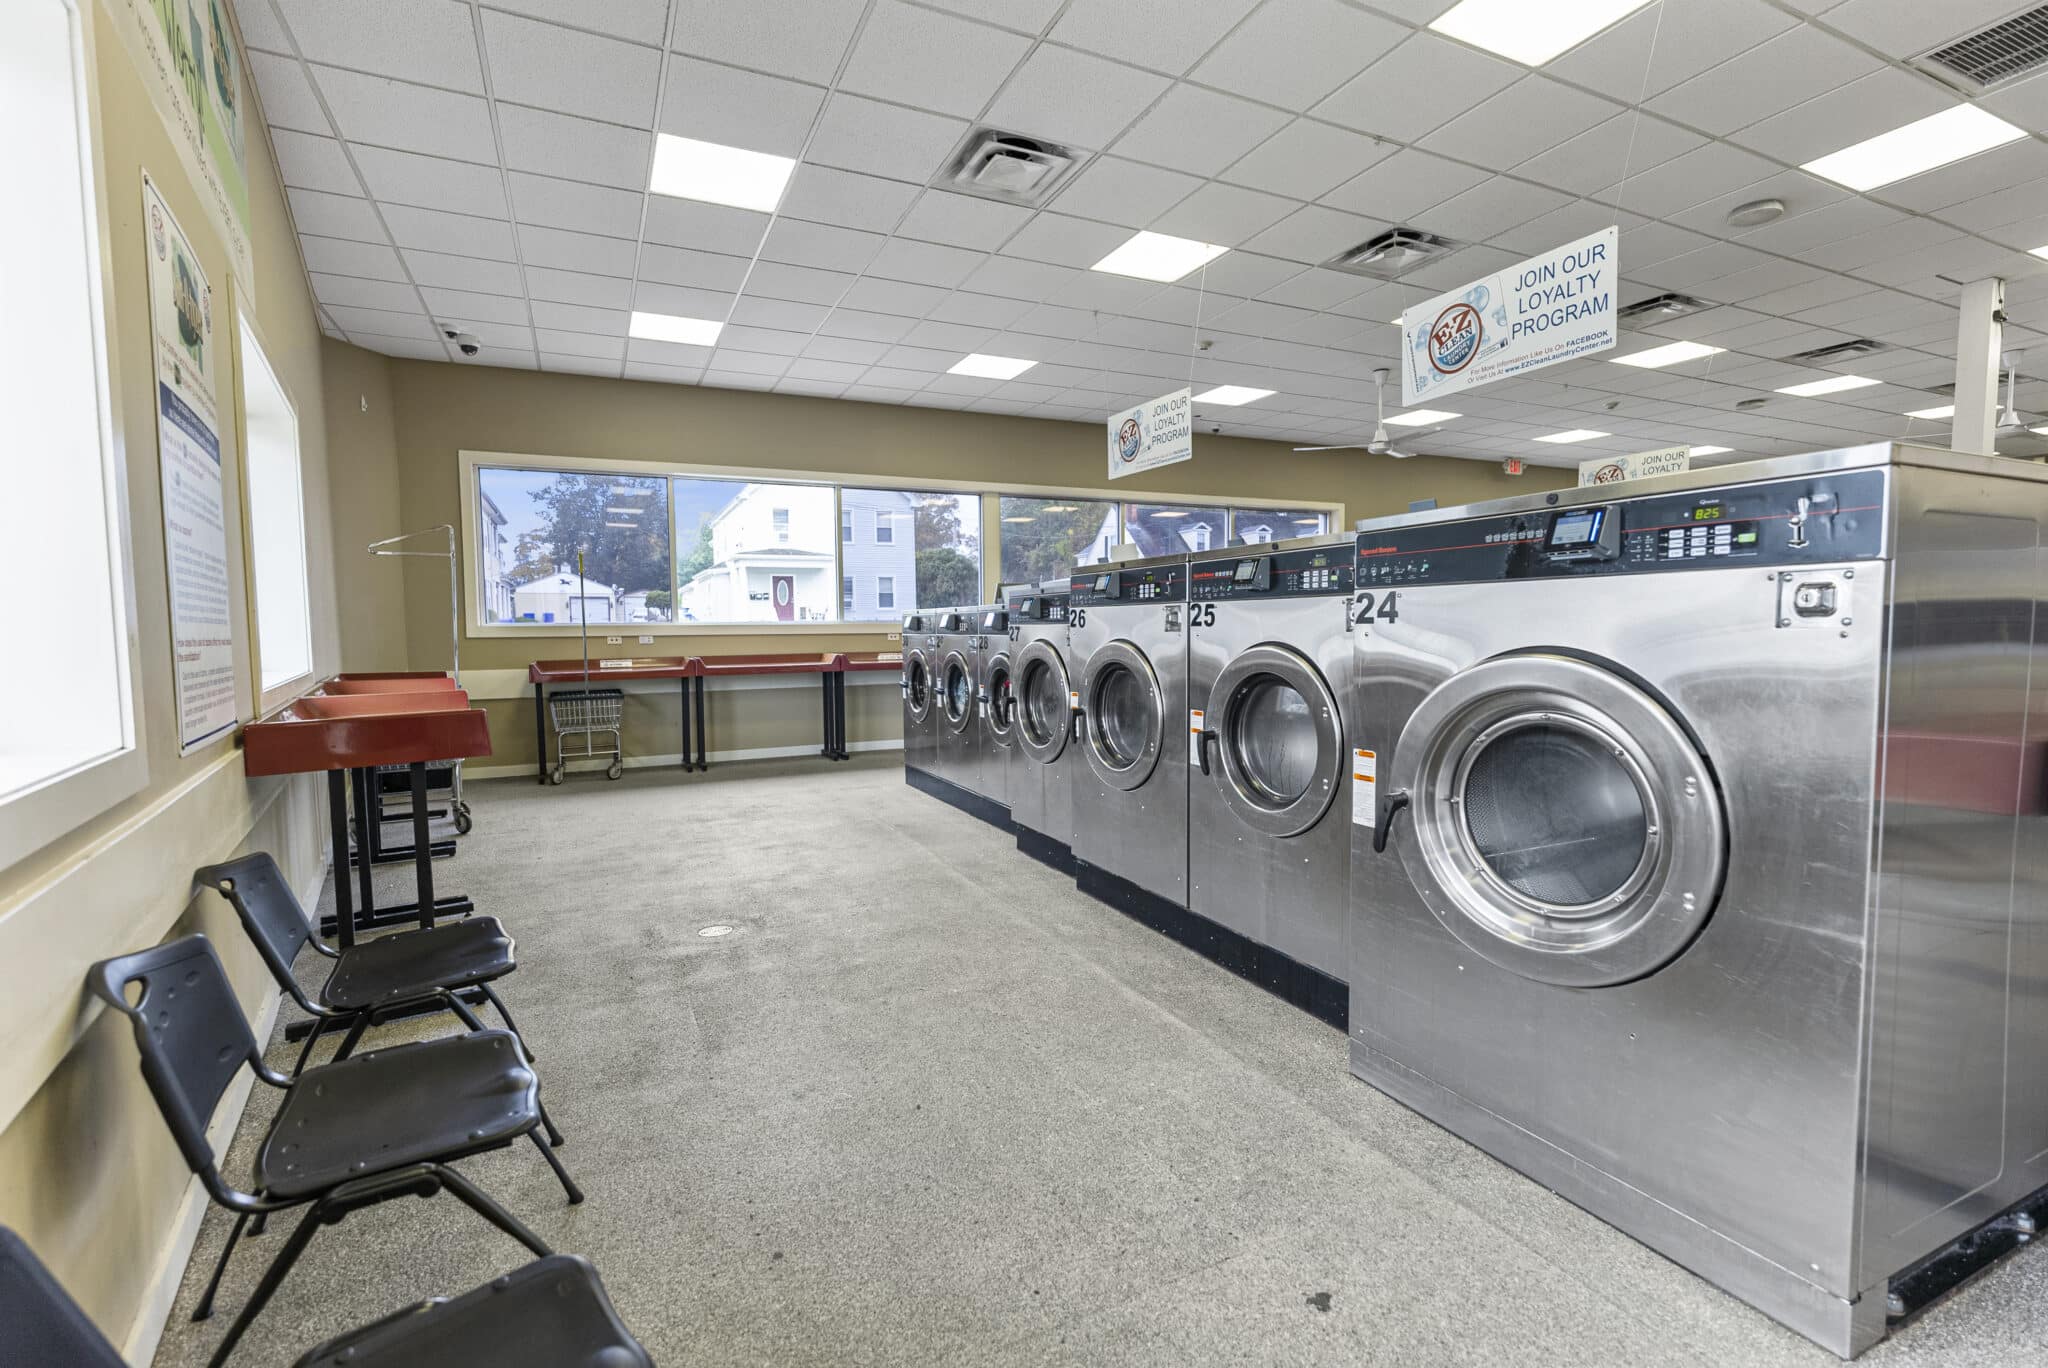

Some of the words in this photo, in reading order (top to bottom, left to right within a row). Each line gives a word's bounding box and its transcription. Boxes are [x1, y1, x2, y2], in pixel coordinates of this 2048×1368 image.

[1515, 262, 1555, 292] JOIN
[1562, 243, 1606, 274] OUR
[1519, 269, 1601, 314] LOYALTY
[1512, 292, 1609, 340] PROGRAM
[1431, 309, 1473, 347] E-Z
[1438, 327, 1473, 356] CLEAN
[1443, 339, 1471, 362] LAUNDRY
[1470, 367, 1481, 376] For
[1481, 363, 1495, 373] More
[1496, 354, 1529, 369] Information
[1530, 349, 1543, 359] Like
[1544, 346, 1554, 355] Us
[1555, 343, 1565, 352] On
[1566, 330, 1609, 348] FACEBOOK
[1448, 346, 1470, 365] CENTER
[1475, 373, 1487, 382] Visit
[1488, 370, 1497, 378] Us
[1497, 368, 1504, 376] At
[1504, 337, 1613, 374] www.EZCleanLaundryCenter.net
[1152, 402, 1169, 418] JOIN
[1170, 396, 1187, 410] OUR
[1154, 411, 1186, 431] LOYALTY
[1152, 425, 1189, 446] PROGRAM
[1641, 455, 1662, 466] JOIN
[1664, 451, 1685, 462] OUR
[1642, 462, 1683, 476] LOYALTY
[1695, 507, 1720, 520] 825
[1070, 609, 1086, 628] 26
[1190, 602, 1216, 628] 25
[1355, 591, 1399, 625] 24
[1009, 626, 1021, 642] 27
